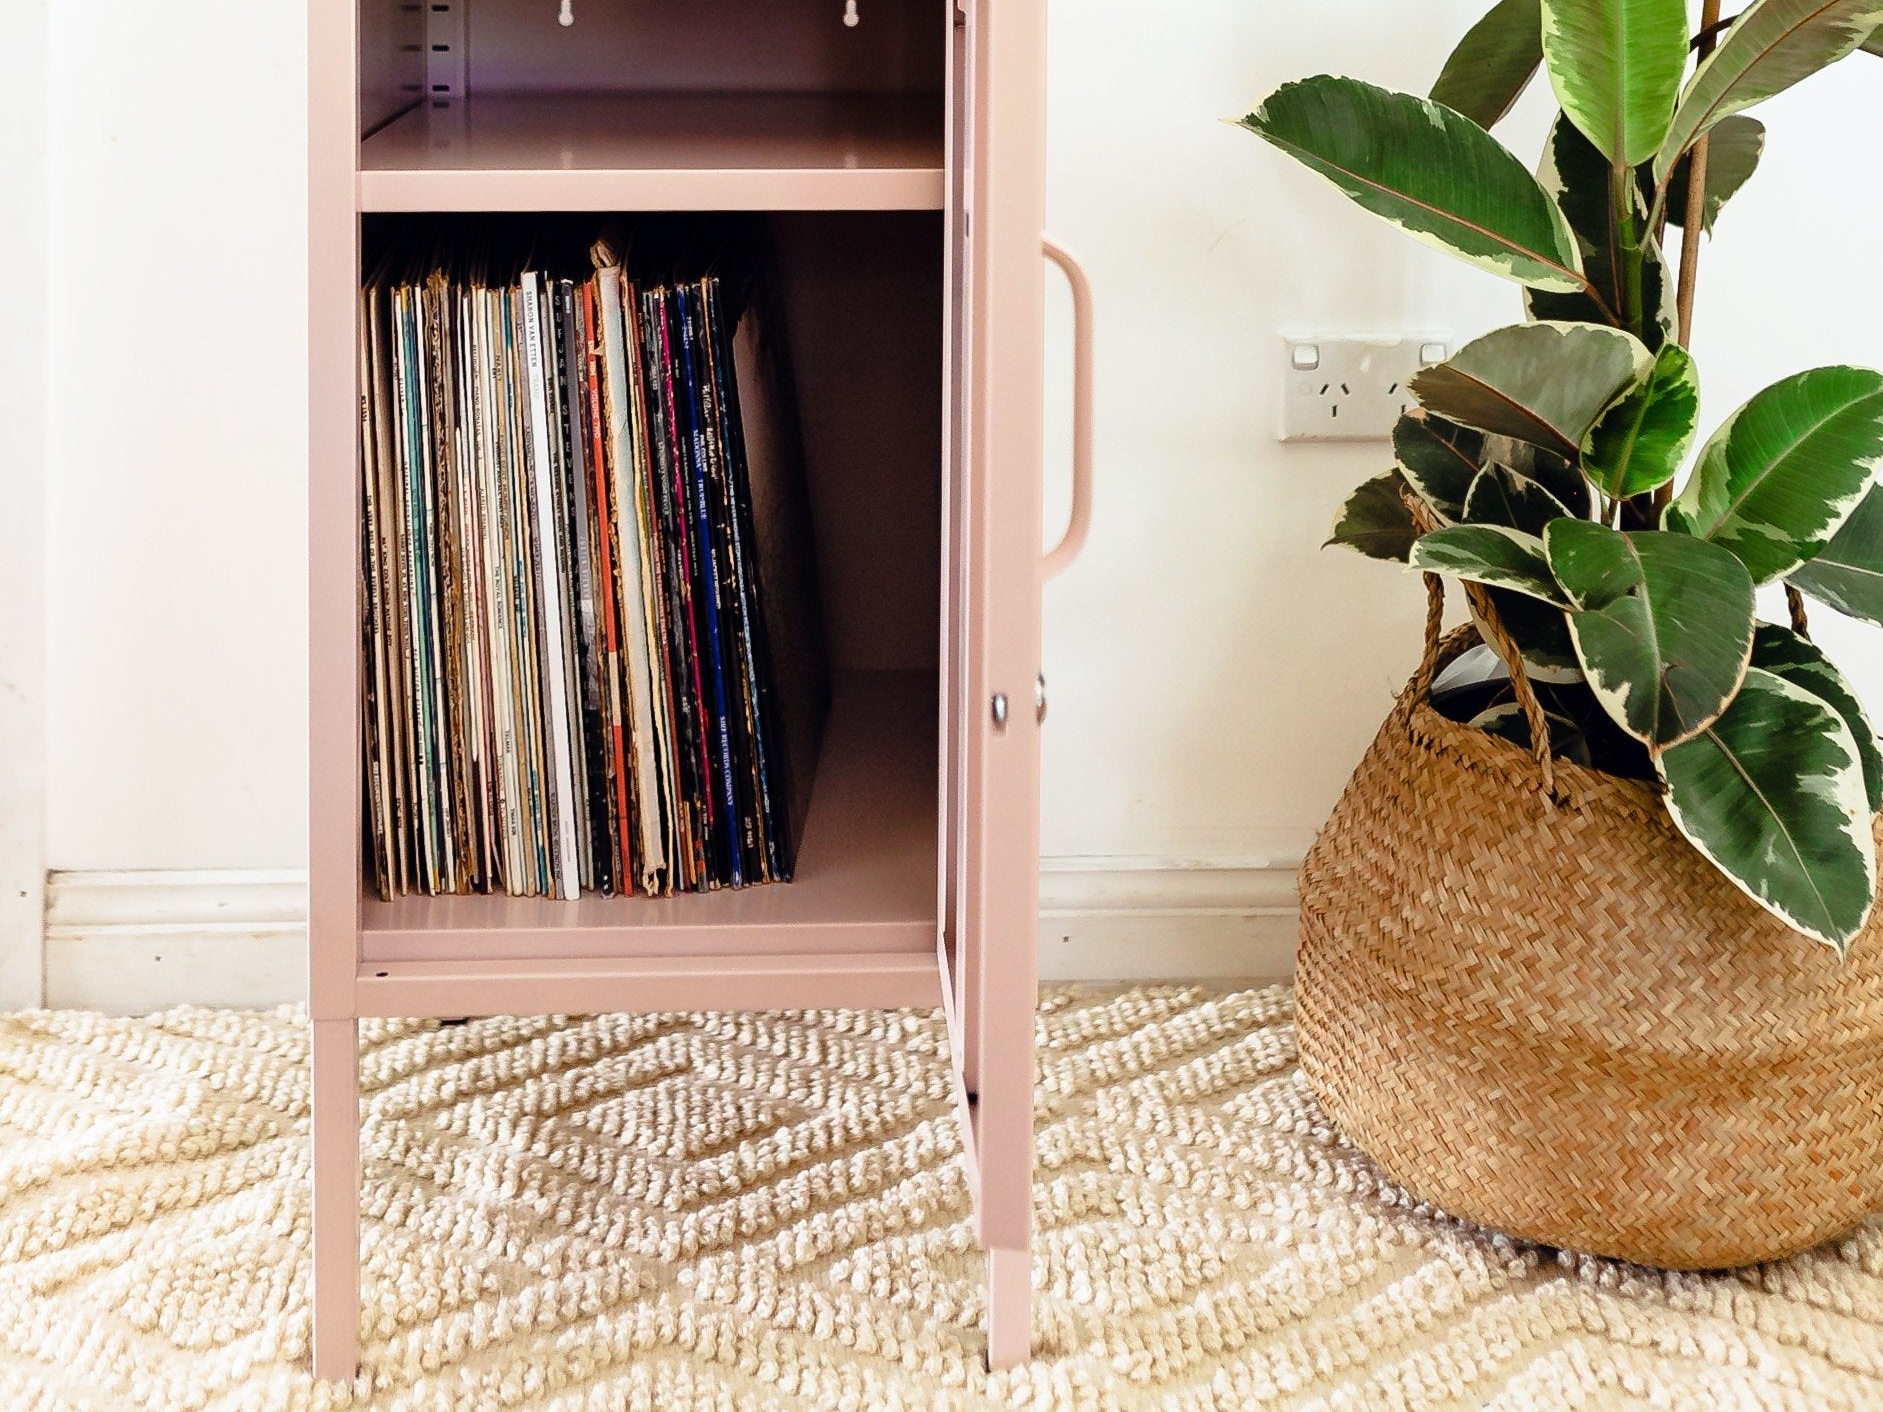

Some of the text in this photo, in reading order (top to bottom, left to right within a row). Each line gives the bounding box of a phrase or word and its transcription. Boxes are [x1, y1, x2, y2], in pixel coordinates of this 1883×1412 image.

[526, 291, 534, 323] SHARON
[528, 325, 536, 341] VAN
[529, 343, 538, 367] ETTEN
[555, 295, 568, 386] SUFJAN
[562, 404, 575, 517] STEVENS
[591, 389, 599, 419] VOLUME
[593, 421, 601, 439] TWO
[693, 429, 702, 466] MADONNA
[699, 499, 707, 520] BLUE
[721, 734, 729, 769] RECORDS
[724, 770, 733, 806] COMPANY
